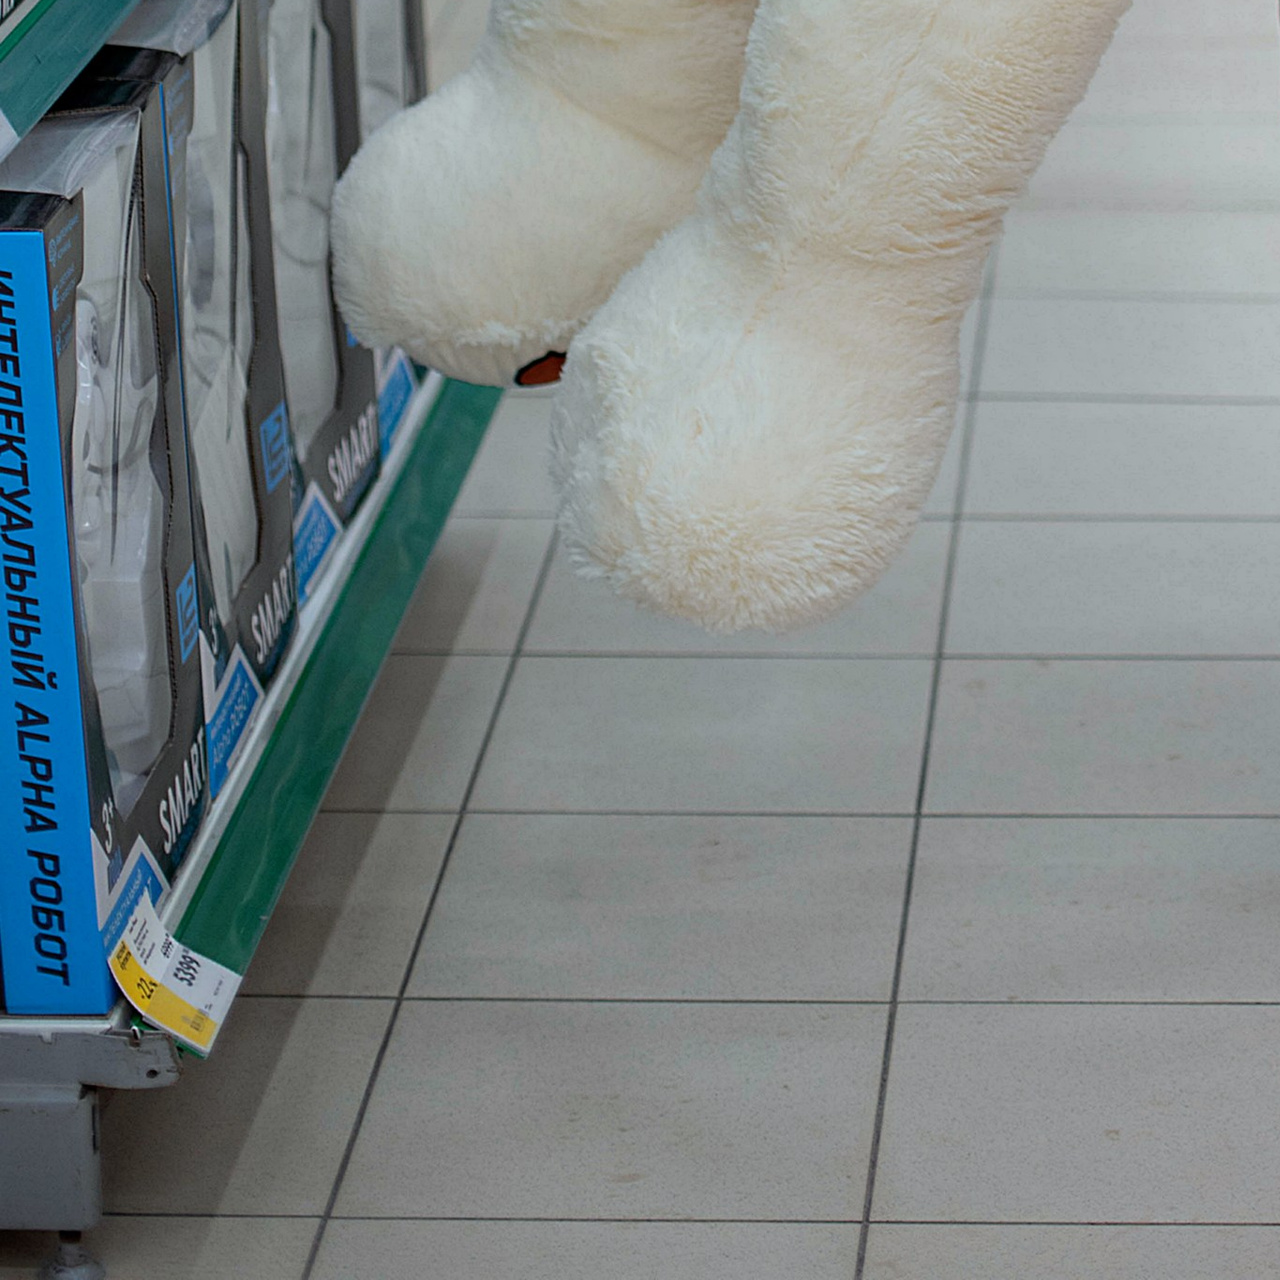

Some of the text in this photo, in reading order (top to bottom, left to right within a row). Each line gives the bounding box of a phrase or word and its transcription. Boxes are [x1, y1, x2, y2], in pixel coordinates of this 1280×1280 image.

[327, 402, 376, 502] SMART
[252, 553, 295, 664] SMART
[15, 701, 57, 834] ALPHA
[160, 727, 206, 854] SMART
[27, 848, 69, 986] РОБОТ
[173, 954, 201, 987] 5399
